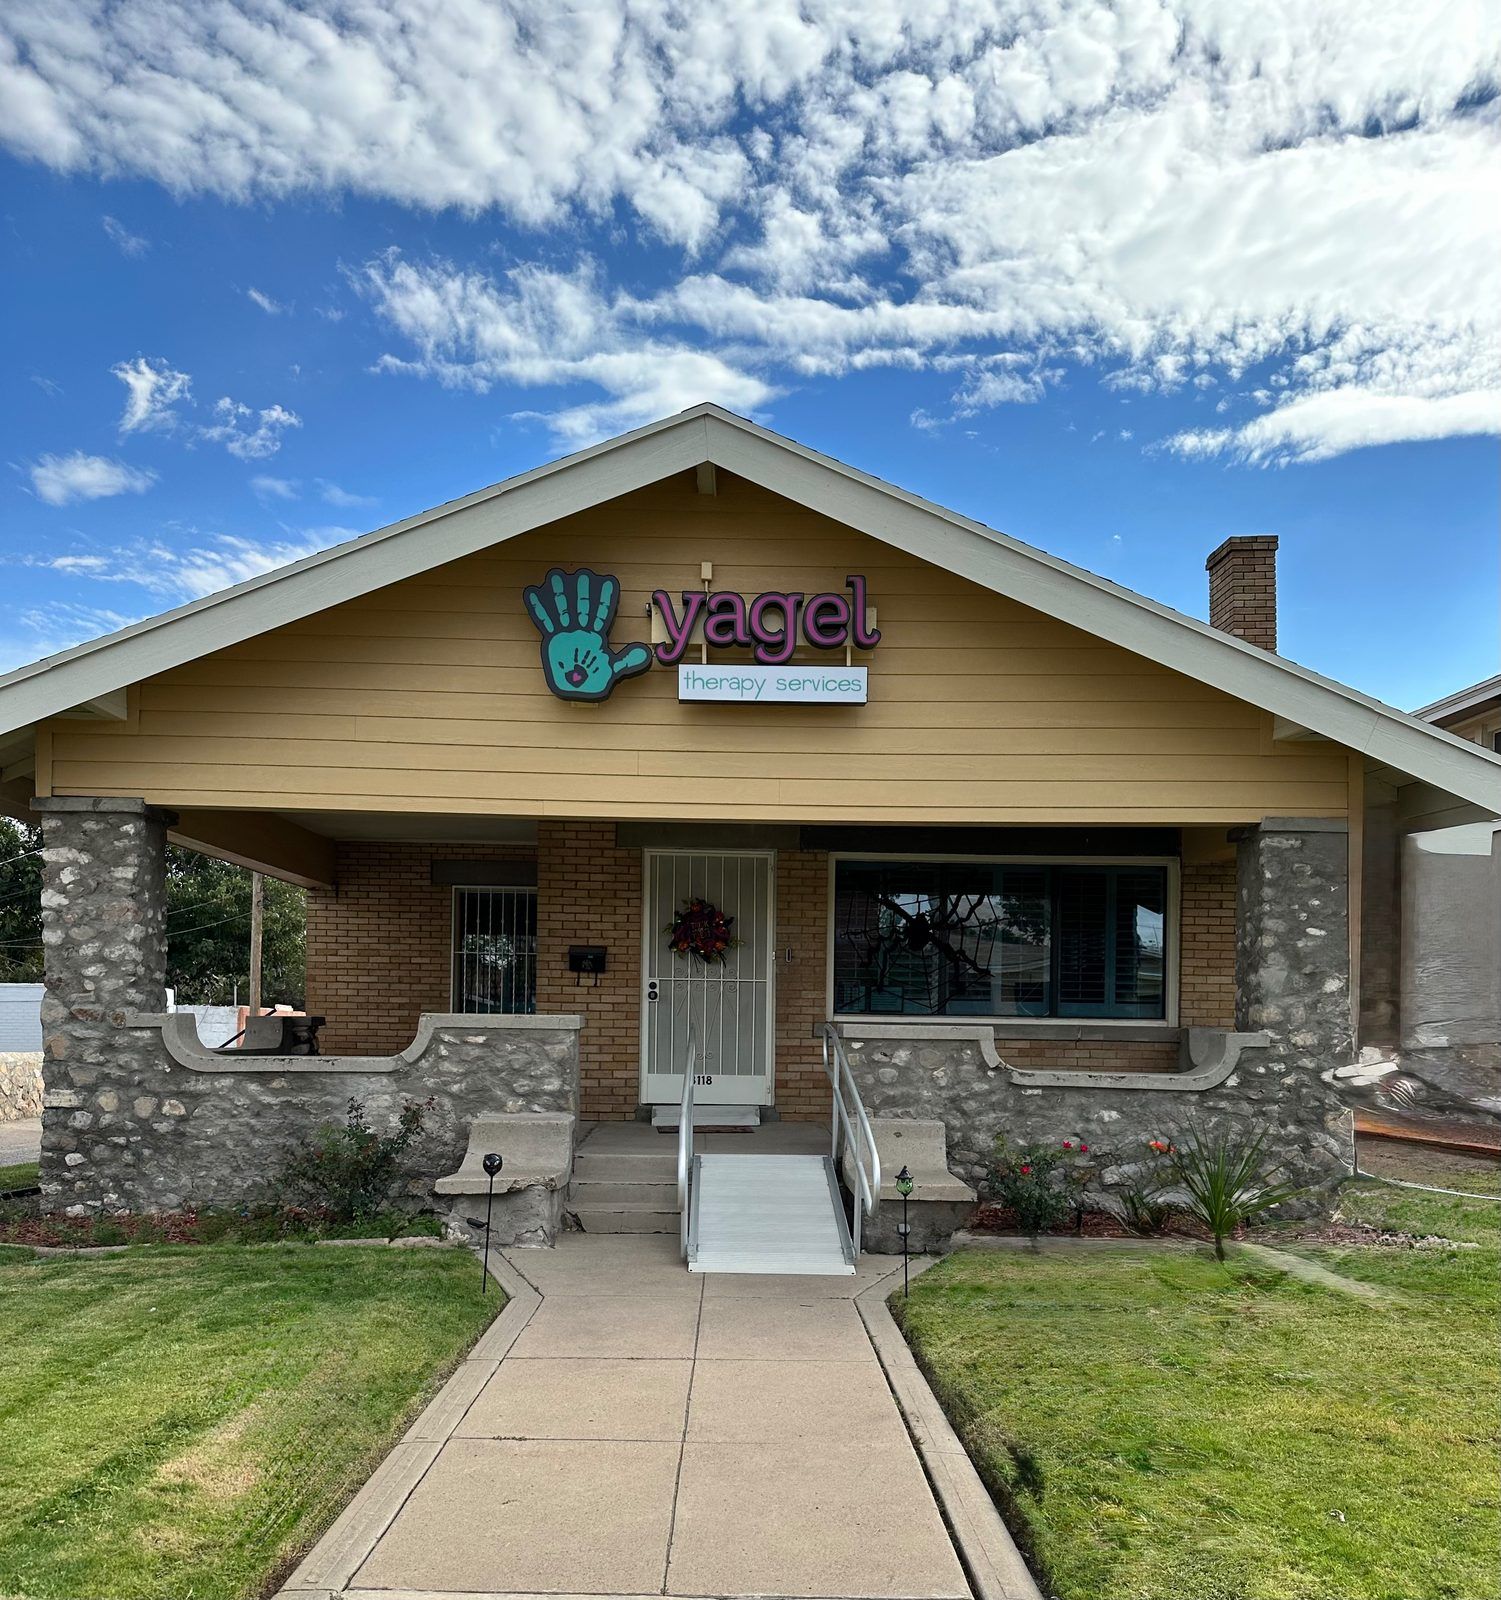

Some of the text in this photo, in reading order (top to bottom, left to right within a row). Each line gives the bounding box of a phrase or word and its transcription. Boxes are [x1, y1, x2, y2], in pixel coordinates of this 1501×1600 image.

[651, 575, 881, 666] yagel
[683, 670, 862, 699] therapy services
